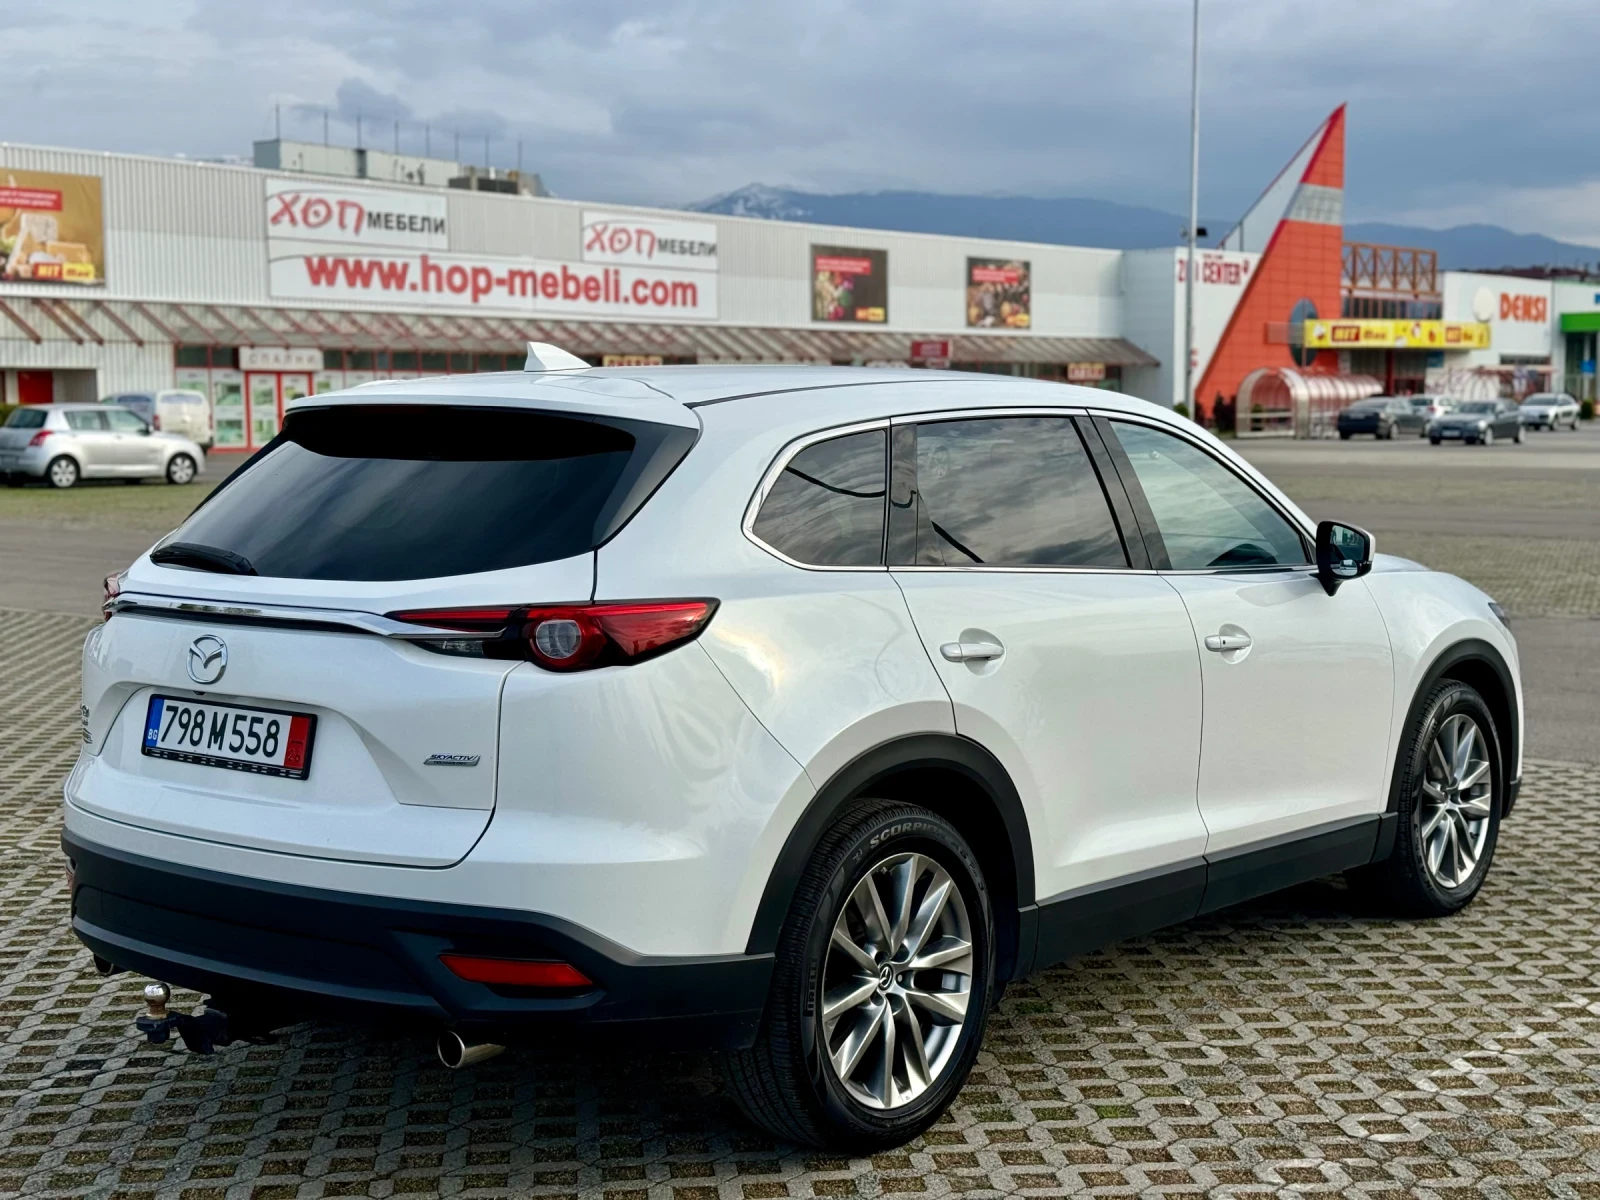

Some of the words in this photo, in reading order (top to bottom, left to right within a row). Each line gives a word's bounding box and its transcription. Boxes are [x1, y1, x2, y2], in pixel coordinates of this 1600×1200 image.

[366, 212, 447, 235] МЕБЕЛИ
[657, 238, 717, 257] МЕБЕЛИ
[304, 254, 698, 308] www.hop-mebeli.com
[147, 729, 159, 741] BG
